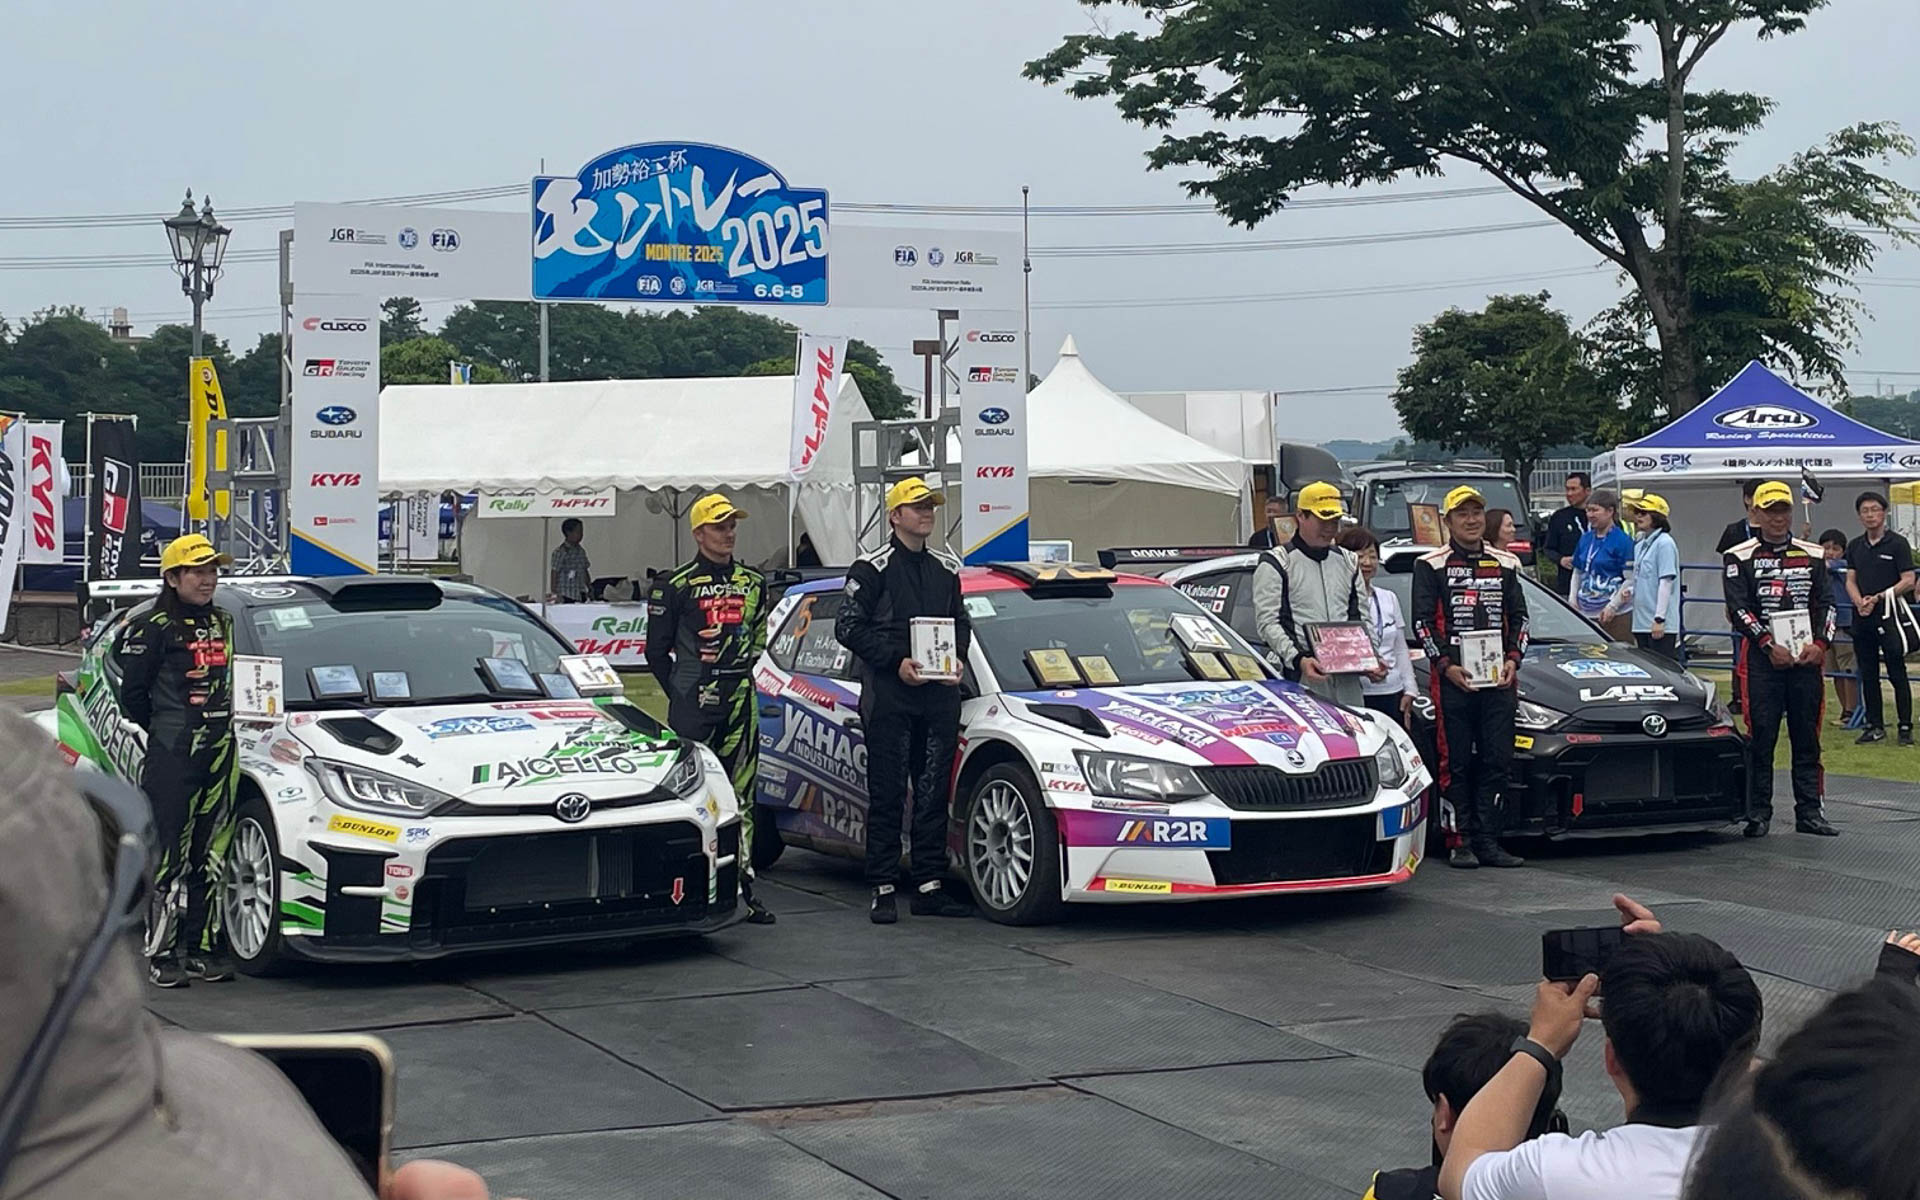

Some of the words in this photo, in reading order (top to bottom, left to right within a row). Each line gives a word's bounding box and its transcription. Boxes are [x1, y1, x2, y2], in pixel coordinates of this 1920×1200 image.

[330, 228, 355, 241] JGR
[721, 199, 829, 278] 2025
[645, 244, 692, 262] MONTRE
[694, 245, 724, 263] 2025
[895, 250, 916, 263] FIA
[954, 251, 974, 263] JGR
[637, 277, 660, 292] FIA
[695, 280, 714, 291] JGR
[754, 284, 804, 298] 6.6-8
[320, 322, 367, 332] CUSCO
[980, 333, 1016, 343] CUSCO
[303, 364, 335, 377] GR
[969, 372, 992, 383] GR
[793, 345, 834, 472] プレイドライ
[1724, 410, 1803, 427] Arai
[310, 430, 362, 439] SUBARU
[1705, 432, 1752, 440] Racing
[1660, 454, 1692, 465] SPK
[1863, 452, 1896, 464] SPK
[977, 466, 1015, 478] KYB
[311, 473, 361, 487] KYB
[32, 436, 55, 550] KYB
[1759, 586, 1784, 596] GR
[1451, 595, 1477, 606] GR
[1098, 701, 1218, 745] YAHAGI
[794, 741, 841, 777] INDUSTRY
[497, 757, 637, 780] AICELLO
[1048, 780, 1087, 791] KYB
[823, 790, 864, 843] R2R
[341, 822, 395, 837] DUNLOP
[406, 827, 432, 837] SPK
[1153, 821, 1208, 842] R2R
[388, 866, 412, 877] TONE
[1117, 883, 1167, 891] DUNLOP
